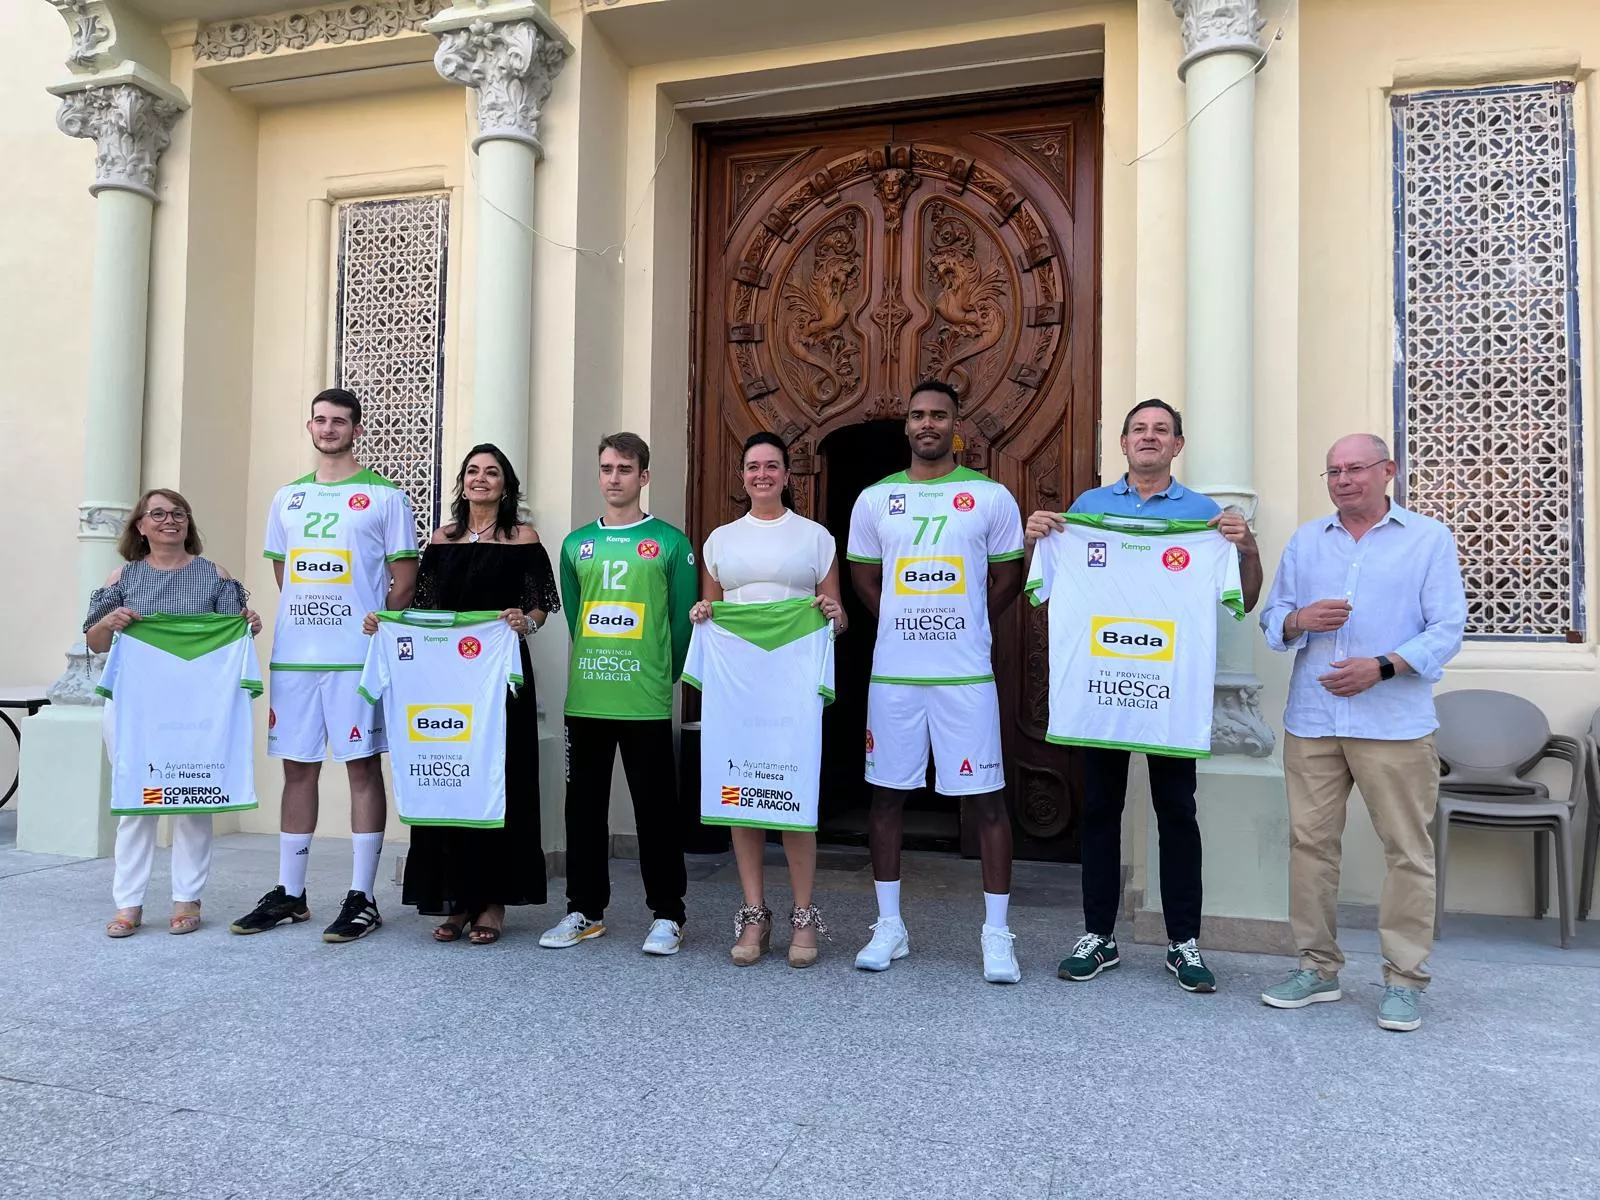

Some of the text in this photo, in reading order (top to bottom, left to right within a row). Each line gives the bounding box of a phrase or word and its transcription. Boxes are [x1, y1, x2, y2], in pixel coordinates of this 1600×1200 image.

[918, 491, 944, 499] Kempa
[303, 511, 340, 539] 22
[912, 515, 948, 545] 77
[1121, 542, 1151, 552] Kempa
[296, 561, 344, 573] Bada
[602, 560, 628, 590] 12
[905, 570, 956, 582] Bada
[588, 614, 635, 627] Bada
[423, 635, 449, 644] Kempa
[1102, 631, 1163, 647] Bada
[417, 717, 464, 729] Bada
[164, 762, 225, 772] Ayuntamiento
[742, 759, 799, 773] Ayuntamiento
[165, 771, 211, 779] de Huesca
[742, 770, 784, 781] de Huesca
[163, 786, 222, 796] GOBIERNO
[740, 787, 793, 801] GOBIERNO
[163, 795, 230, 805] DE ARAGON
[740, 797, 800, 812] DE ARAGON
